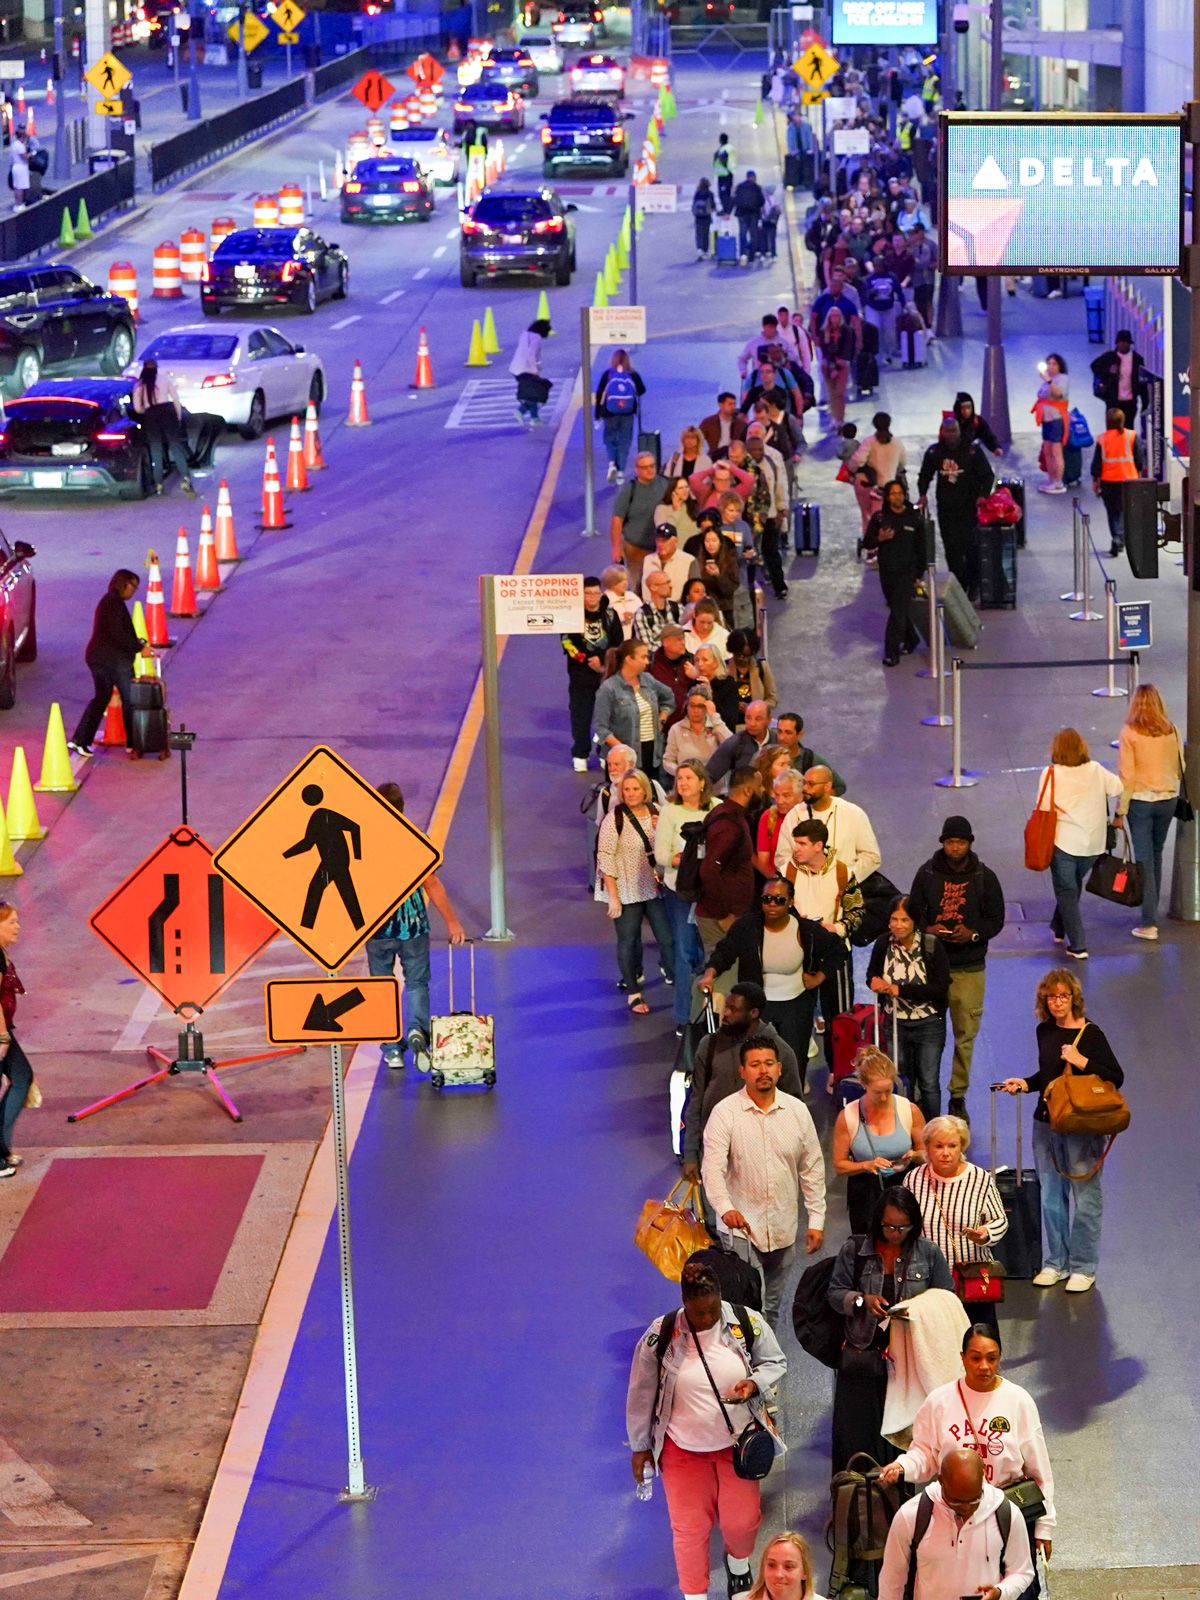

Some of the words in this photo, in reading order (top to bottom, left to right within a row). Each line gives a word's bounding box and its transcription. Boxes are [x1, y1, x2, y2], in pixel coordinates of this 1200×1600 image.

[1018, 157, 1159, 187] DELTA
[500, 579, 518, 588] NO
[521, 577, 578, 587] STOPPING
[500, 589, 516, 598] OR
[520, 588, 579, 598] STANDING
